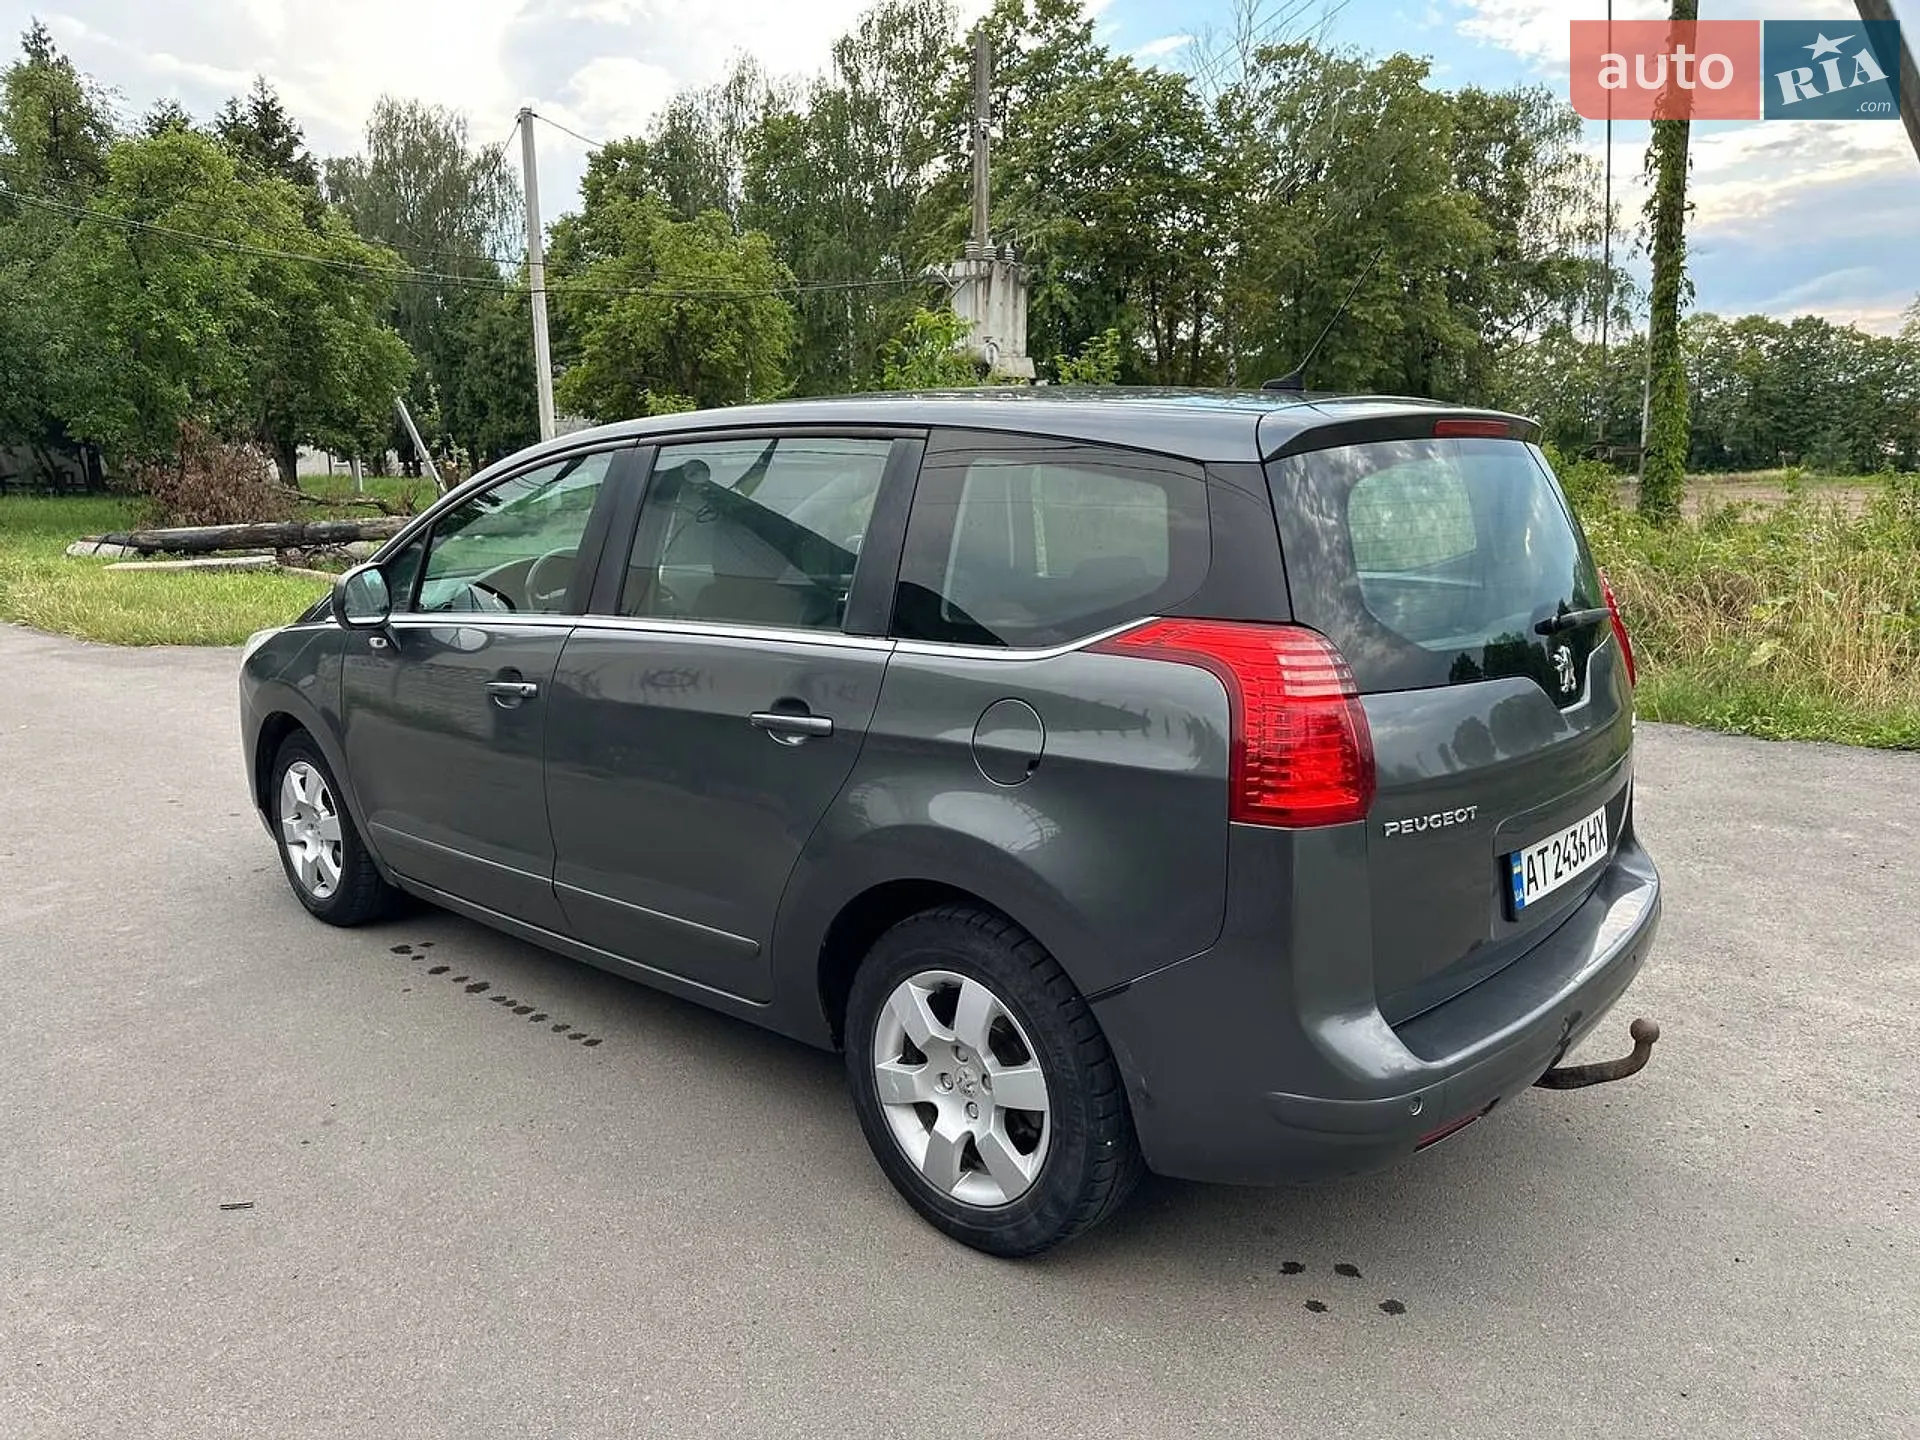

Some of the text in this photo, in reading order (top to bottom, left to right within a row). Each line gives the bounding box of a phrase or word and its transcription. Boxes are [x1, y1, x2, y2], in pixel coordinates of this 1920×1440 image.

[1384, 805, 1478, 837] PEUGEOT
[1526, 812, 1606, 896] AT 2436 HX
